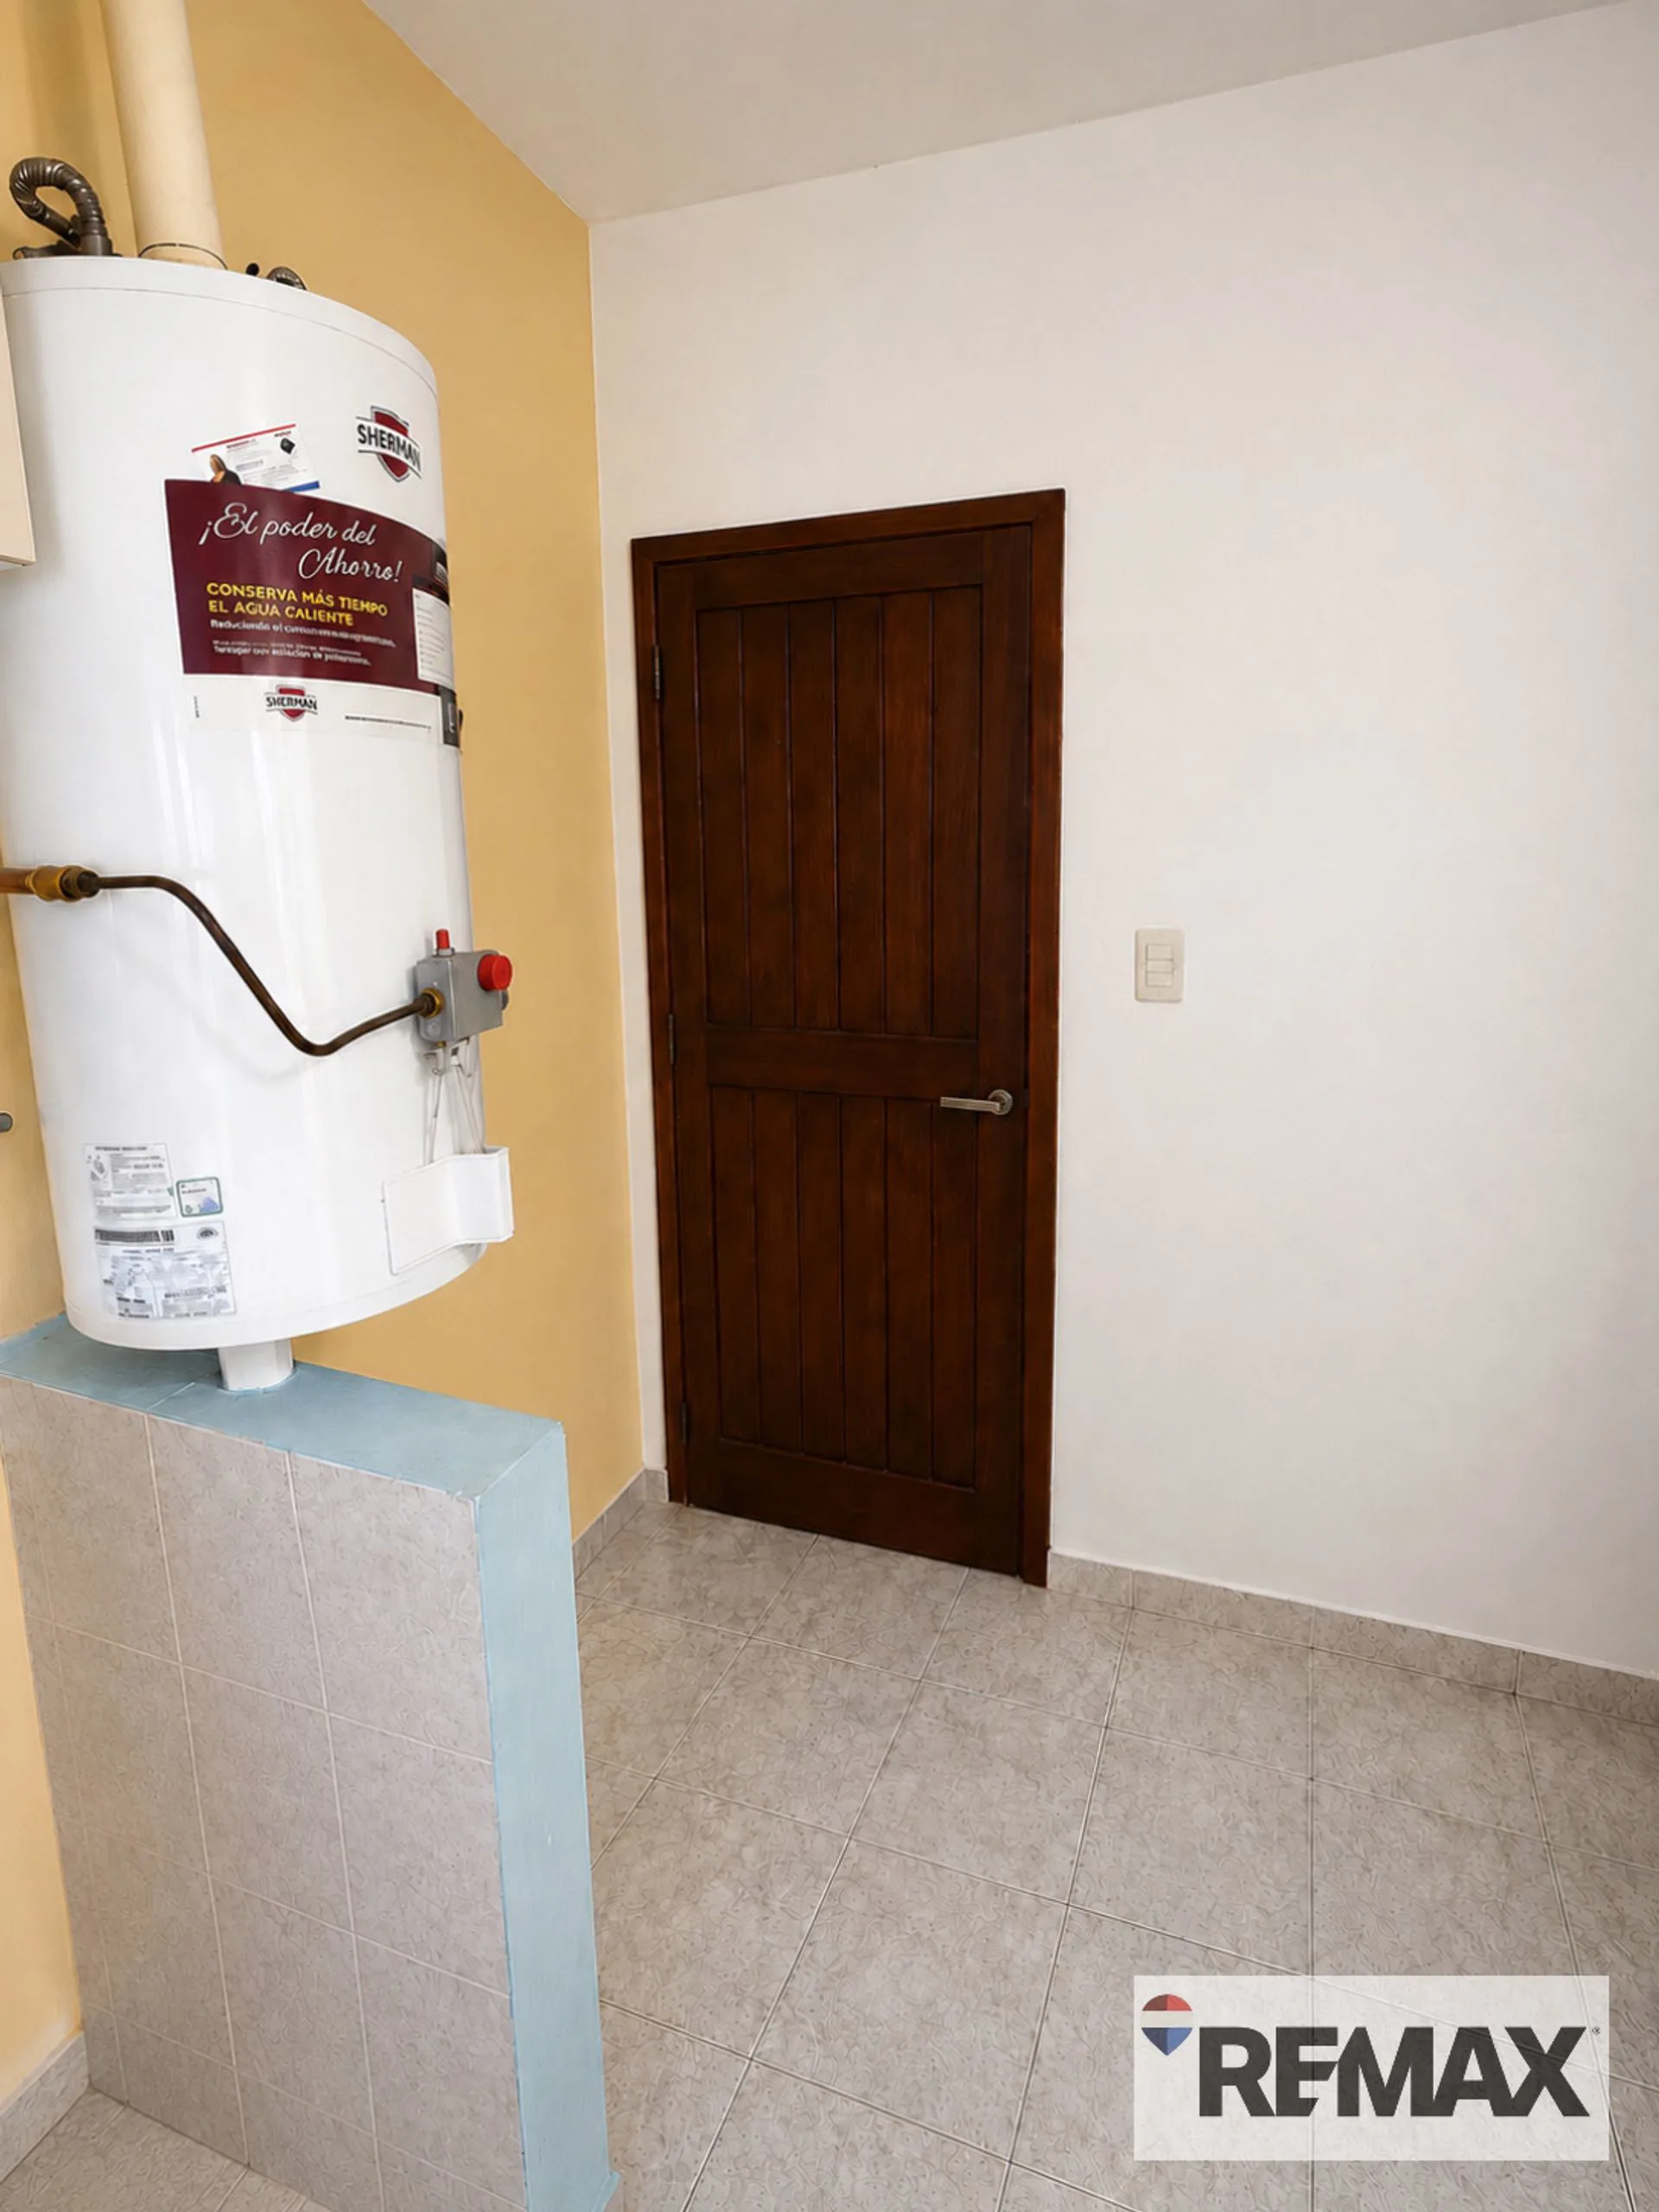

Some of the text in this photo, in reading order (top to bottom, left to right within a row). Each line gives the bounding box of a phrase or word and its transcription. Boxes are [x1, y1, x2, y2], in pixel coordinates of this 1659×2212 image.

[357, 423, 421, 472] SHERMAN
[198, 502, 377, 546] ¡El poder del
[298, 546, 403, 582] Ahorro!
[206, 582, 389, 617] CONSERVA MÁS TIEMPO
[208, 600, 353, 626] EL AGUA CALIENTE
[266, 696, 318, 710] SHERMAN
